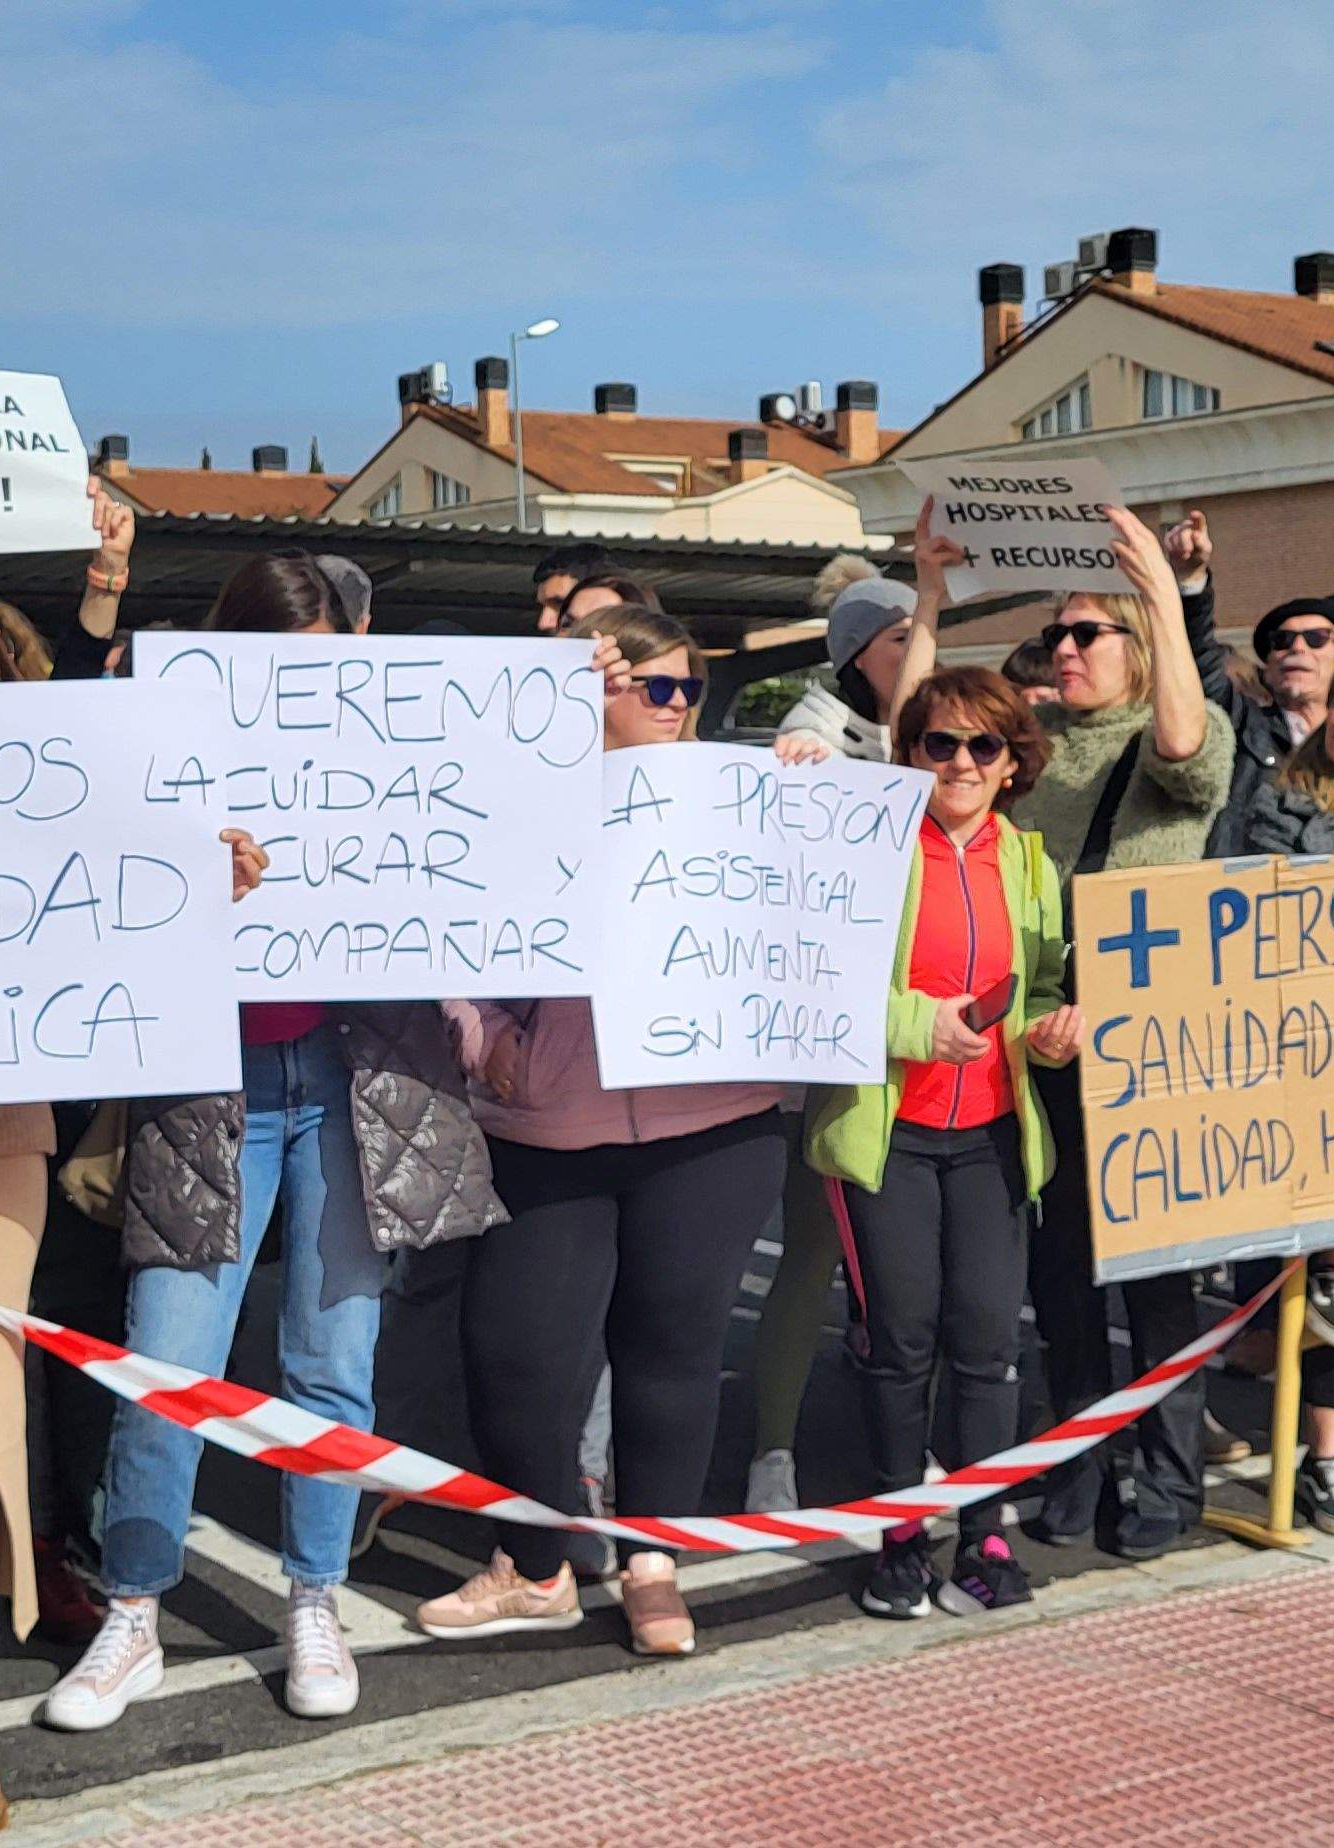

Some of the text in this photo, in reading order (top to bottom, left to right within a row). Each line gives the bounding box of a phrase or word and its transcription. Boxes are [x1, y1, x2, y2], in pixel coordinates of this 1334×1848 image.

[945, 500, 1113, 526] HOSPITALES
[947, 477, 1073, 494] MEJORES
[991, 545, 1121, 570] RECURSO
[144, 755, 216, 805] LA
[603, 761, 922, 851] A PRESIÓN
[631, 850, 883, 924] ASISTENCIAL
[662, 925, 842, 995] AUMENTA
[642, 993, 868, 1068] SIN PARAR
[1092, 997, 1334, 1110] SANIDAD
